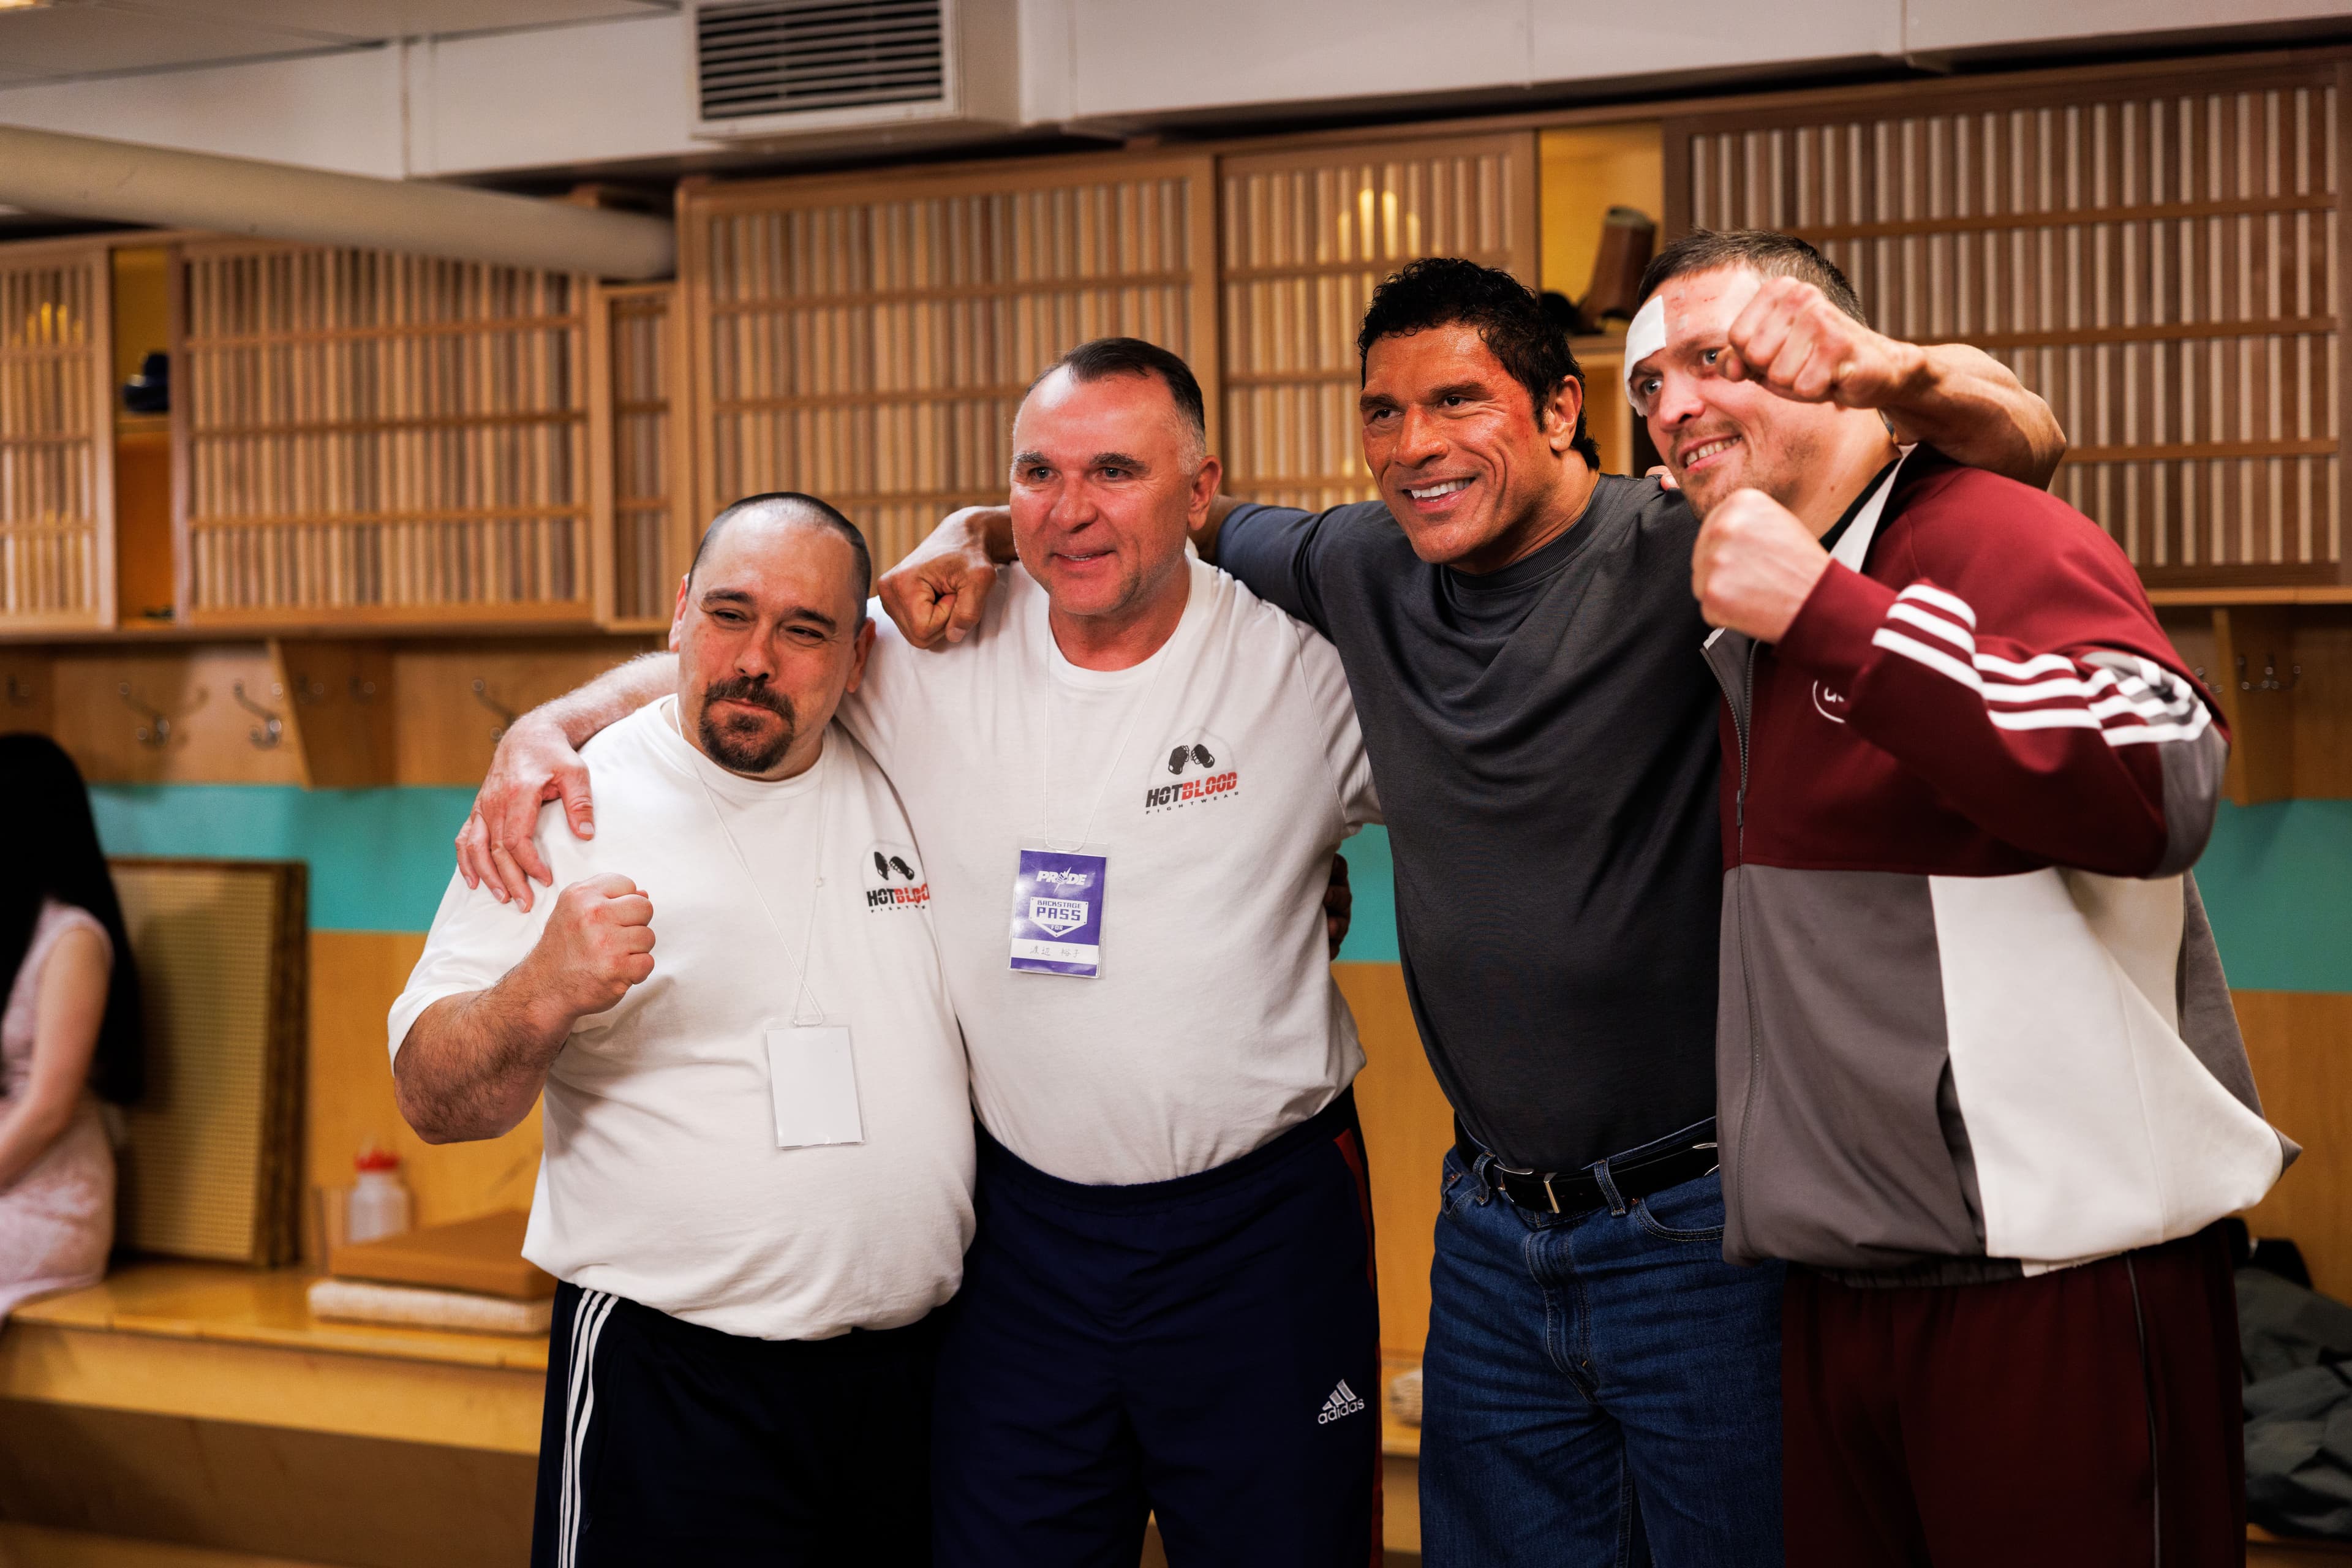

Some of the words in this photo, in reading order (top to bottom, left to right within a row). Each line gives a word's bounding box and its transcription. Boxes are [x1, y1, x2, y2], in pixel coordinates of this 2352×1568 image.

[1145, 772, 1237, 808] HOTBLOOD
[867, 883, 930, 907] HOTBLOO
[1037, 900, 1082, 909] BACKSTAGE
[1036, 907, 1080, 921] PASS
[1318, 1398, 1365, 1424] adidas
